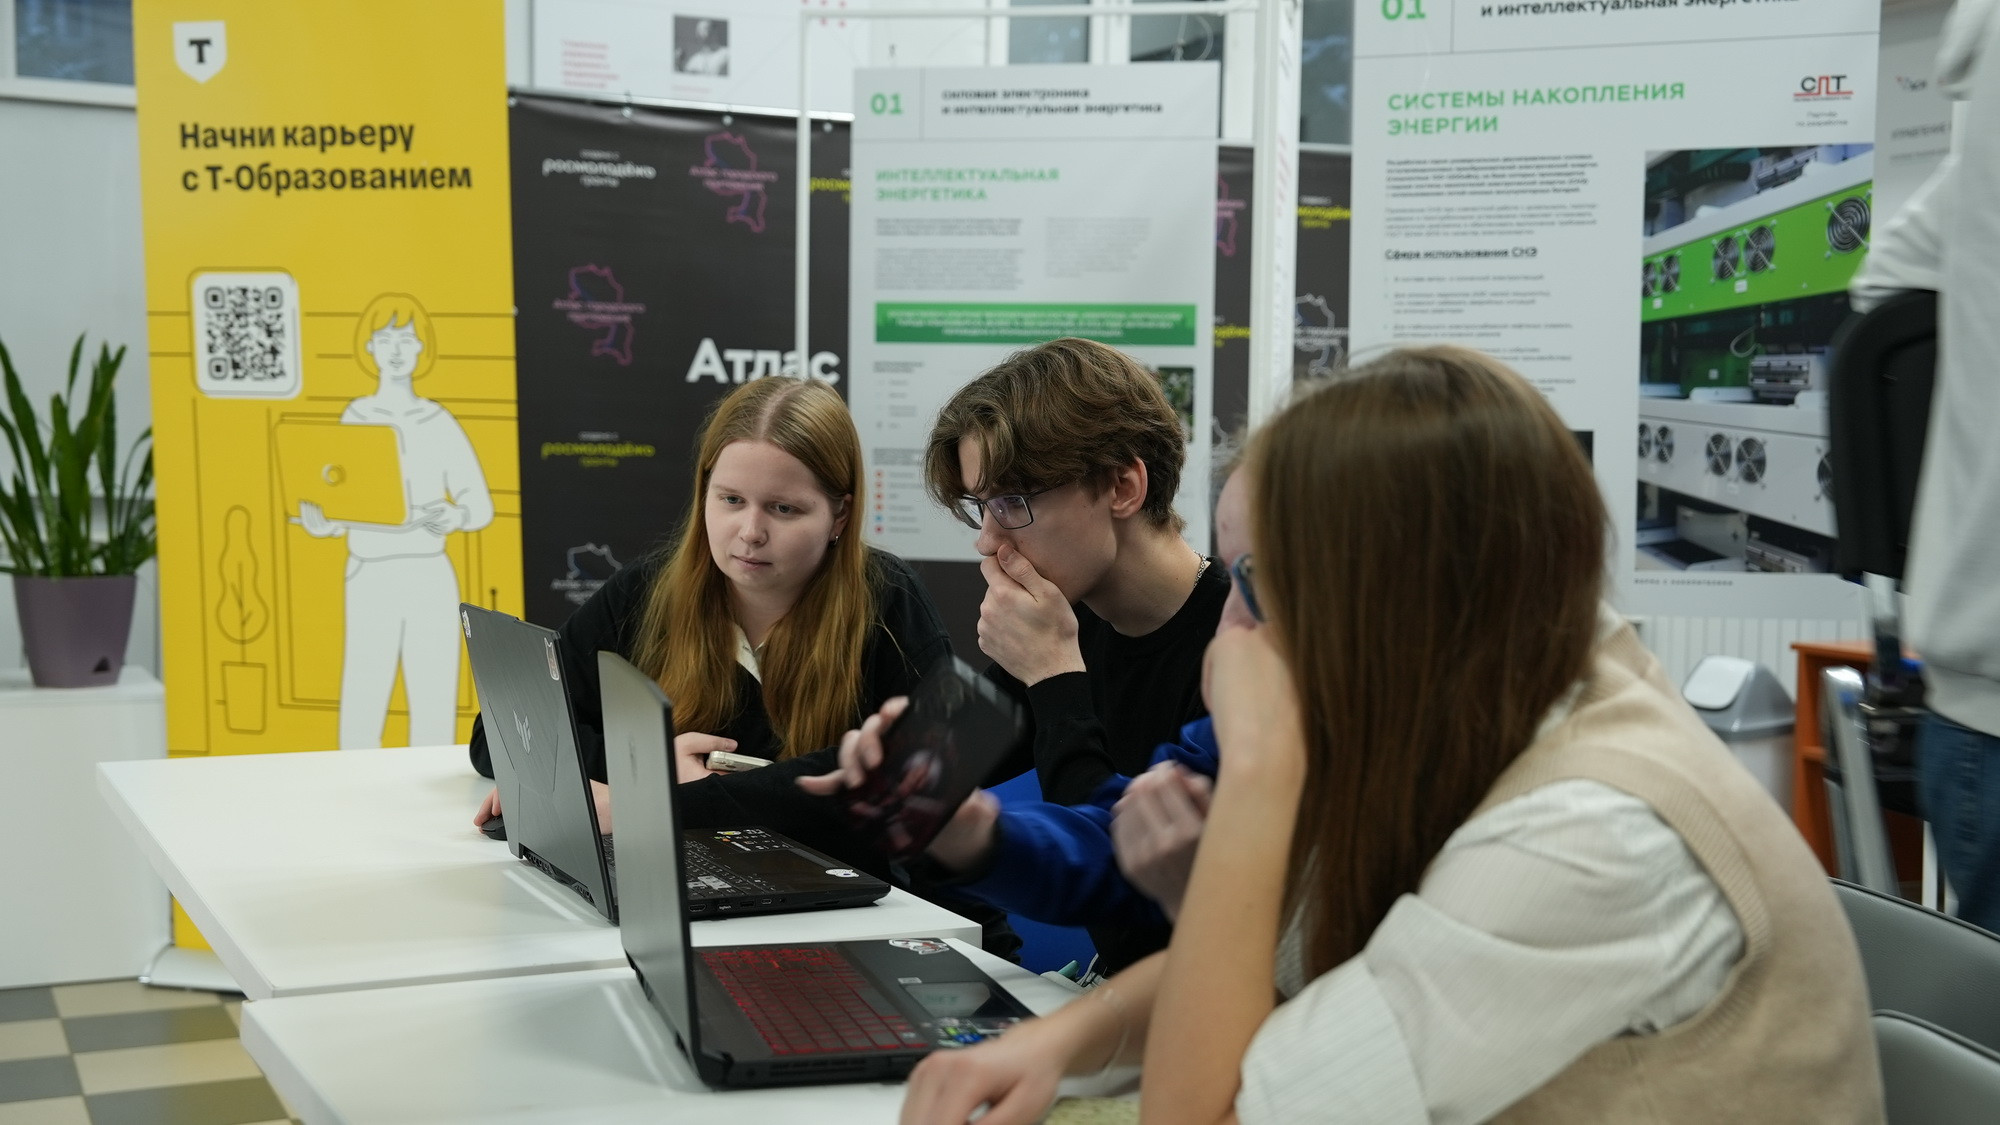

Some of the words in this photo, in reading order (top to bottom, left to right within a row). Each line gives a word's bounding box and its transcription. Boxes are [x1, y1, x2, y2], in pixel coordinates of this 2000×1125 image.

[1481, 6, 1493, 17] и
[1497, 0, 1678, 15] интеллектуальная
[188, 38, 212, 65] Т
[870, 93, 902, 115] 01
[942, 90, 998, 100] силовая
[1001, 90, 1090, 102] электроника
[1388, 90, 1505, 111] СИСТЕМЫ
[1512, 82, 1685, 105] НАКОПЛЕНИЯ
[941, 105, 951, 116] и
[953, 104, 1080, 117] интеллектуальная
[1083, 103, 1163, 116] энергетика
[1388, 116, 1498, 136] ЭНЕРГИИ
[180, 123, 276, 149] Начни
[282, 122, 415, 154] карьеру
[181, 171, 199, 192] с
[207, 162, 472, 197] Т-Образованием
[875, 168, 1060, 183] ИНТЕЛЛЕКТУАЛЬНАЯ
[876, 187, 988, 201] ЭНЕРГЕТИКА
[1385, 249, 1421, 262] Сфера
[685, 337, 841, 386] Атлас
